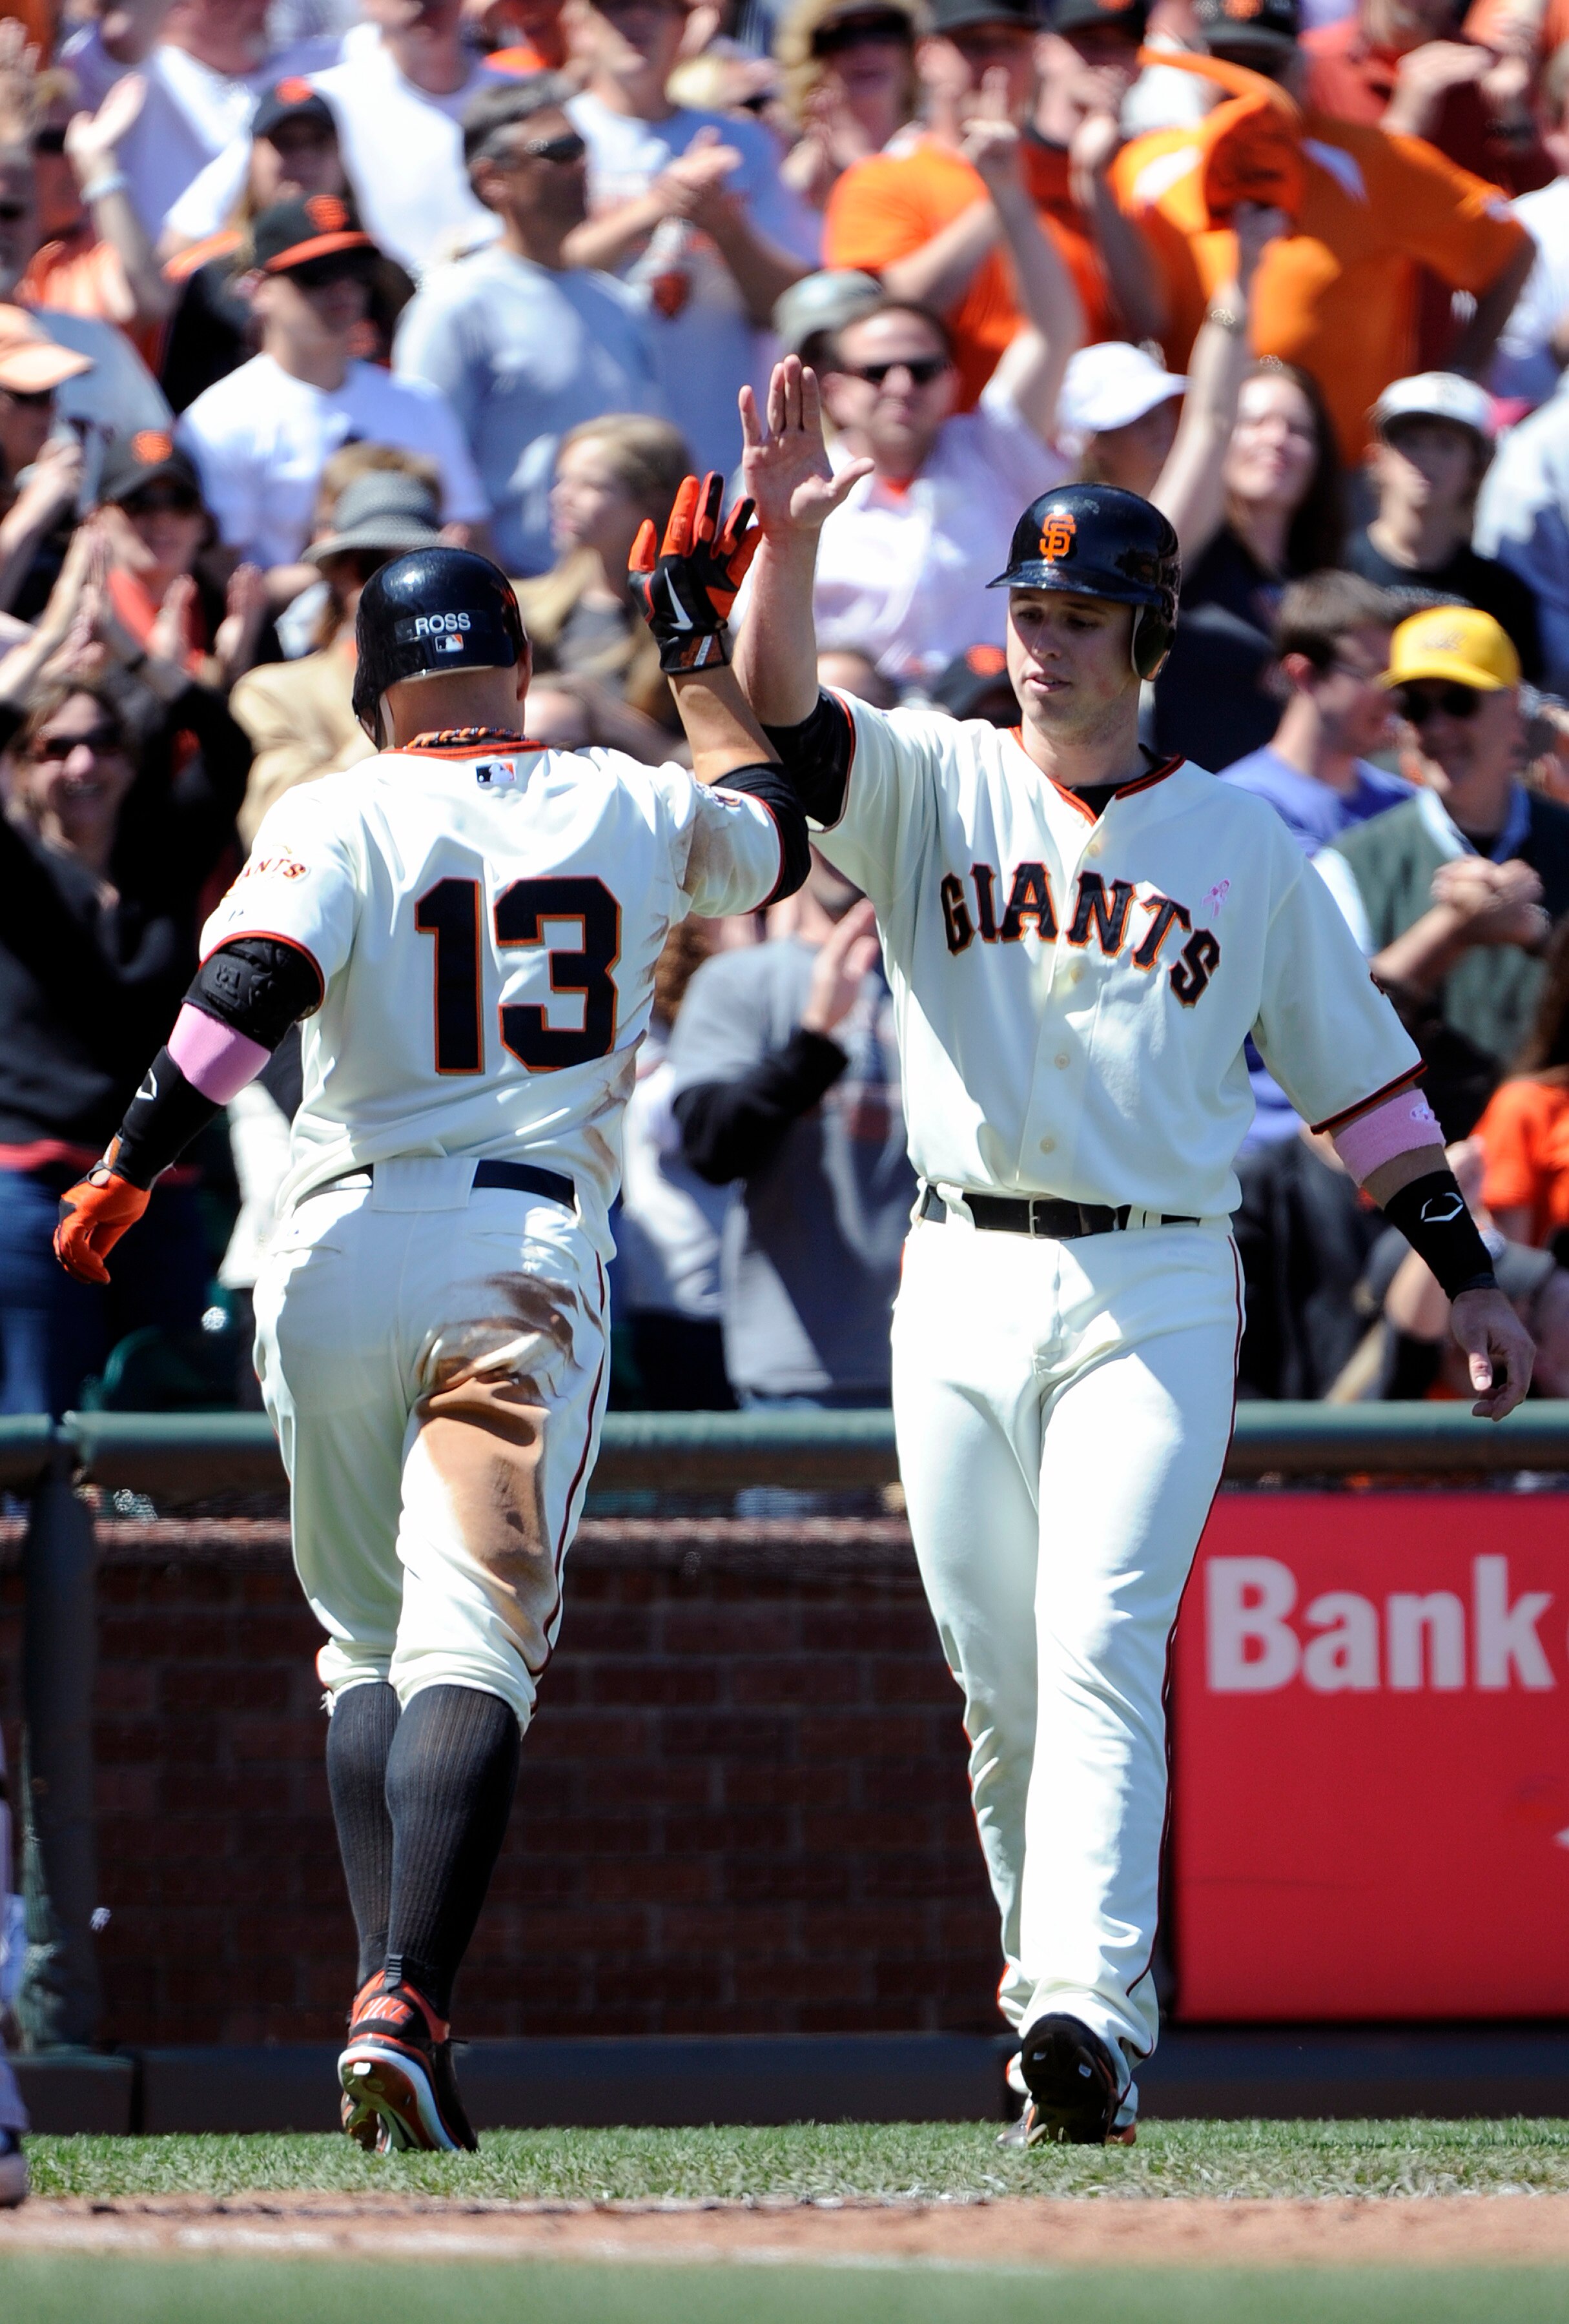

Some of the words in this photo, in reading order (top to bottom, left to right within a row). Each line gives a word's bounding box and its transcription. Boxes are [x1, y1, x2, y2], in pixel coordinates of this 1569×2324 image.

[415, 612, 471, 635] ROSS
[415, 875, 622, 1075] 13
[940, 861, 1220, 1008] GIANTS
[1205, 1553, 1557, 1696] Bank
[356, 1995, 414, 2025] NIKE
